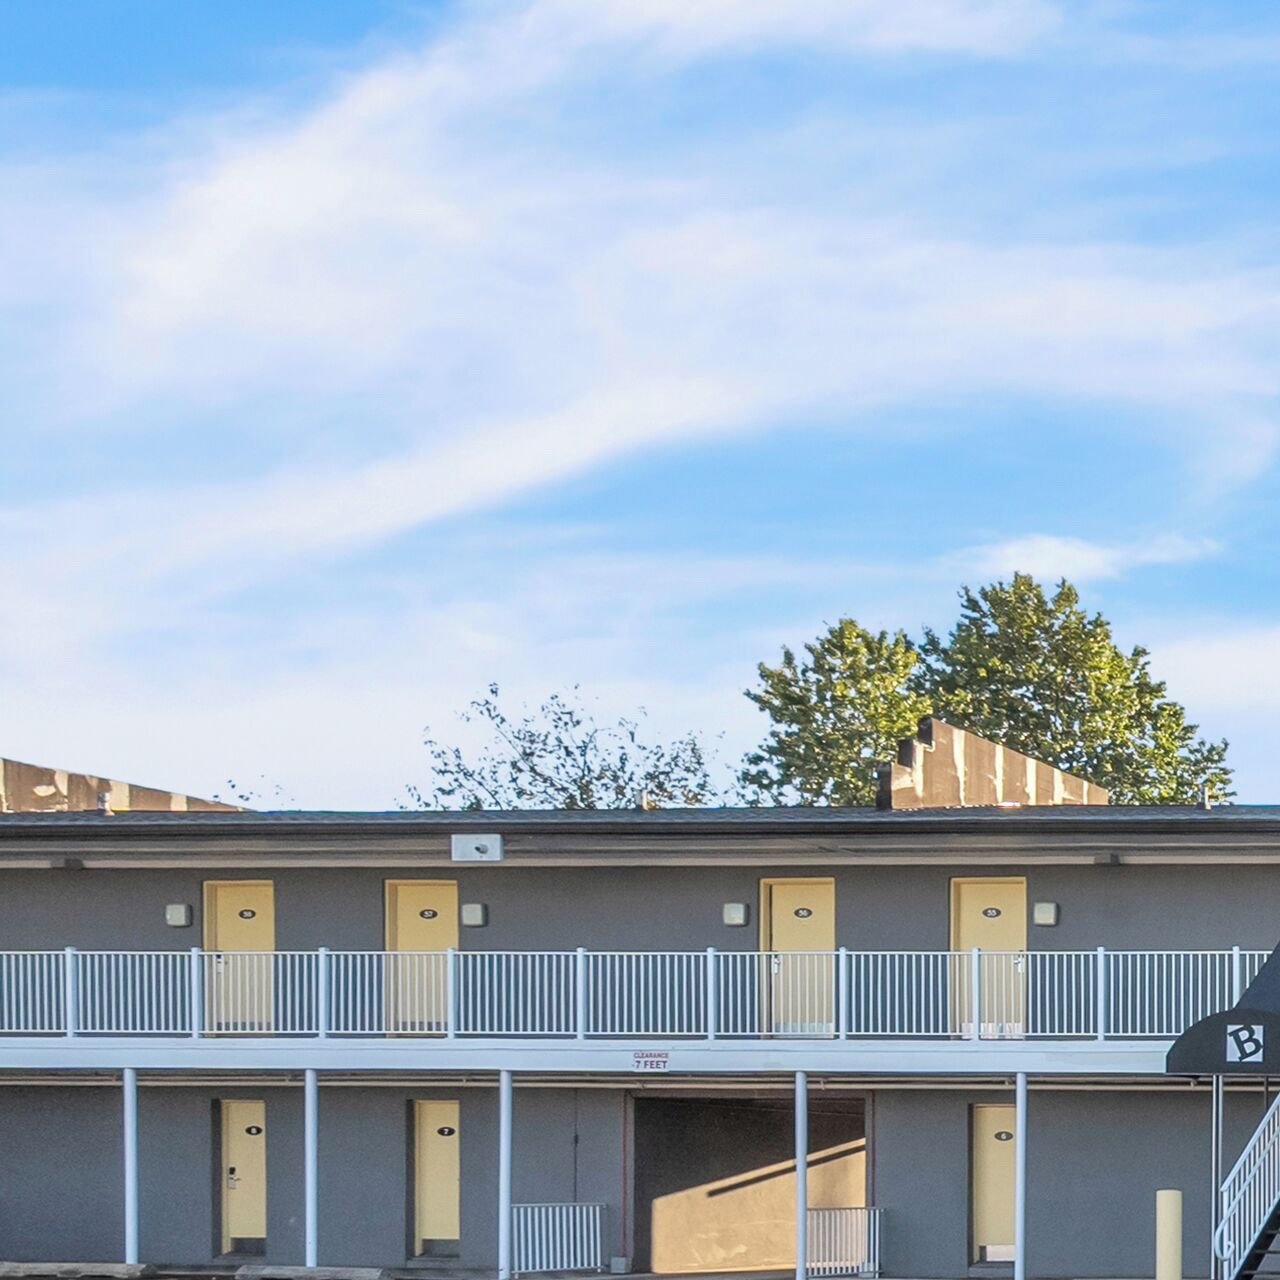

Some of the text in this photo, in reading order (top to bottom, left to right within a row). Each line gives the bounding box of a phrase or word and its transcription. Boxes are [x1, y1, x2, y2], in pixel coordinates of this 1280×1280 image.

[1227, 1024, 1263, 1062] B
[635, 1060, 668, 1069] 7 FEET
